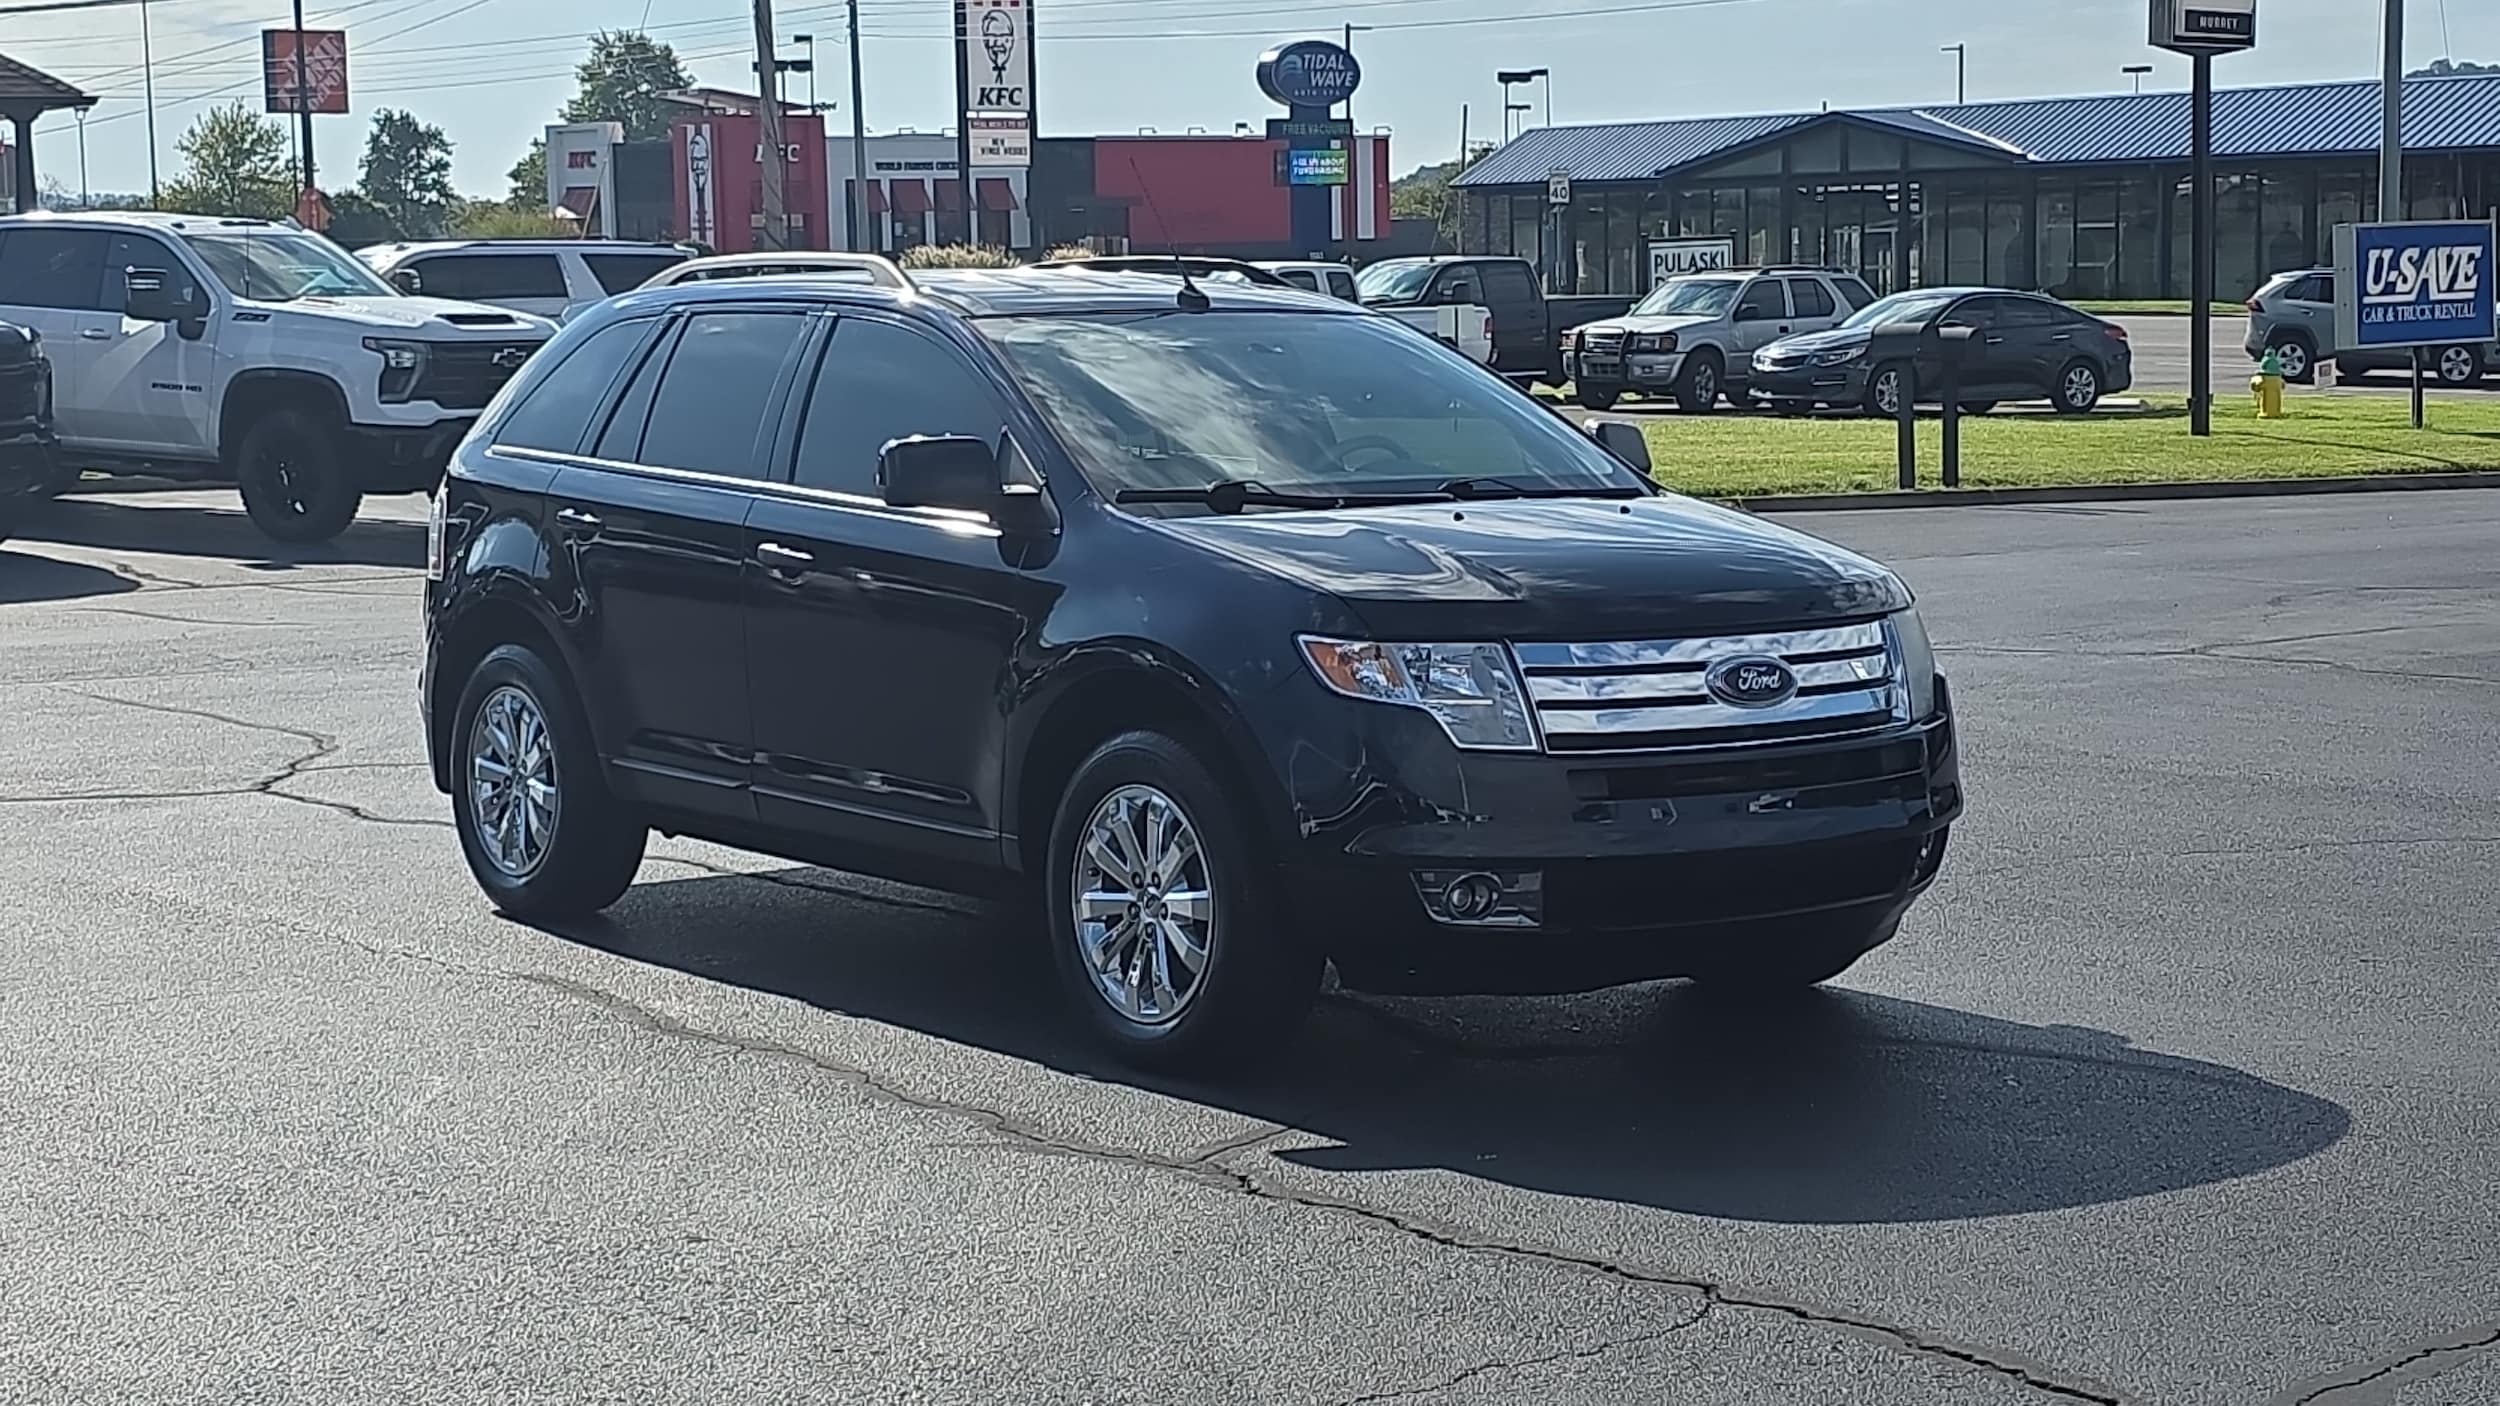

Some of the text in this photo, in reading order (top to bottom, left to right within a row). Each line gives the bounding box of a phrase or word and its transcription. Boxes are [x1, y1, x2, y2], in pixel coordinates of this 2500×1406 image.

[1303, 53, 1345, 70] TIDAL
[1310, 71, 1354, 87] WAVE
[977, 87, 1022, 106] KFC
[567, 151, 597, 169] KFC
[1551, 186, 1568, 199] 40
[1654, 250, 1725, 274] PULASKI
[2364, 245, 2483, 302] U-SAVE
[2362, 302, 2477, 323] CAR & TRUCK RENTAL
[1738, 666, 1782, 690] Ford
